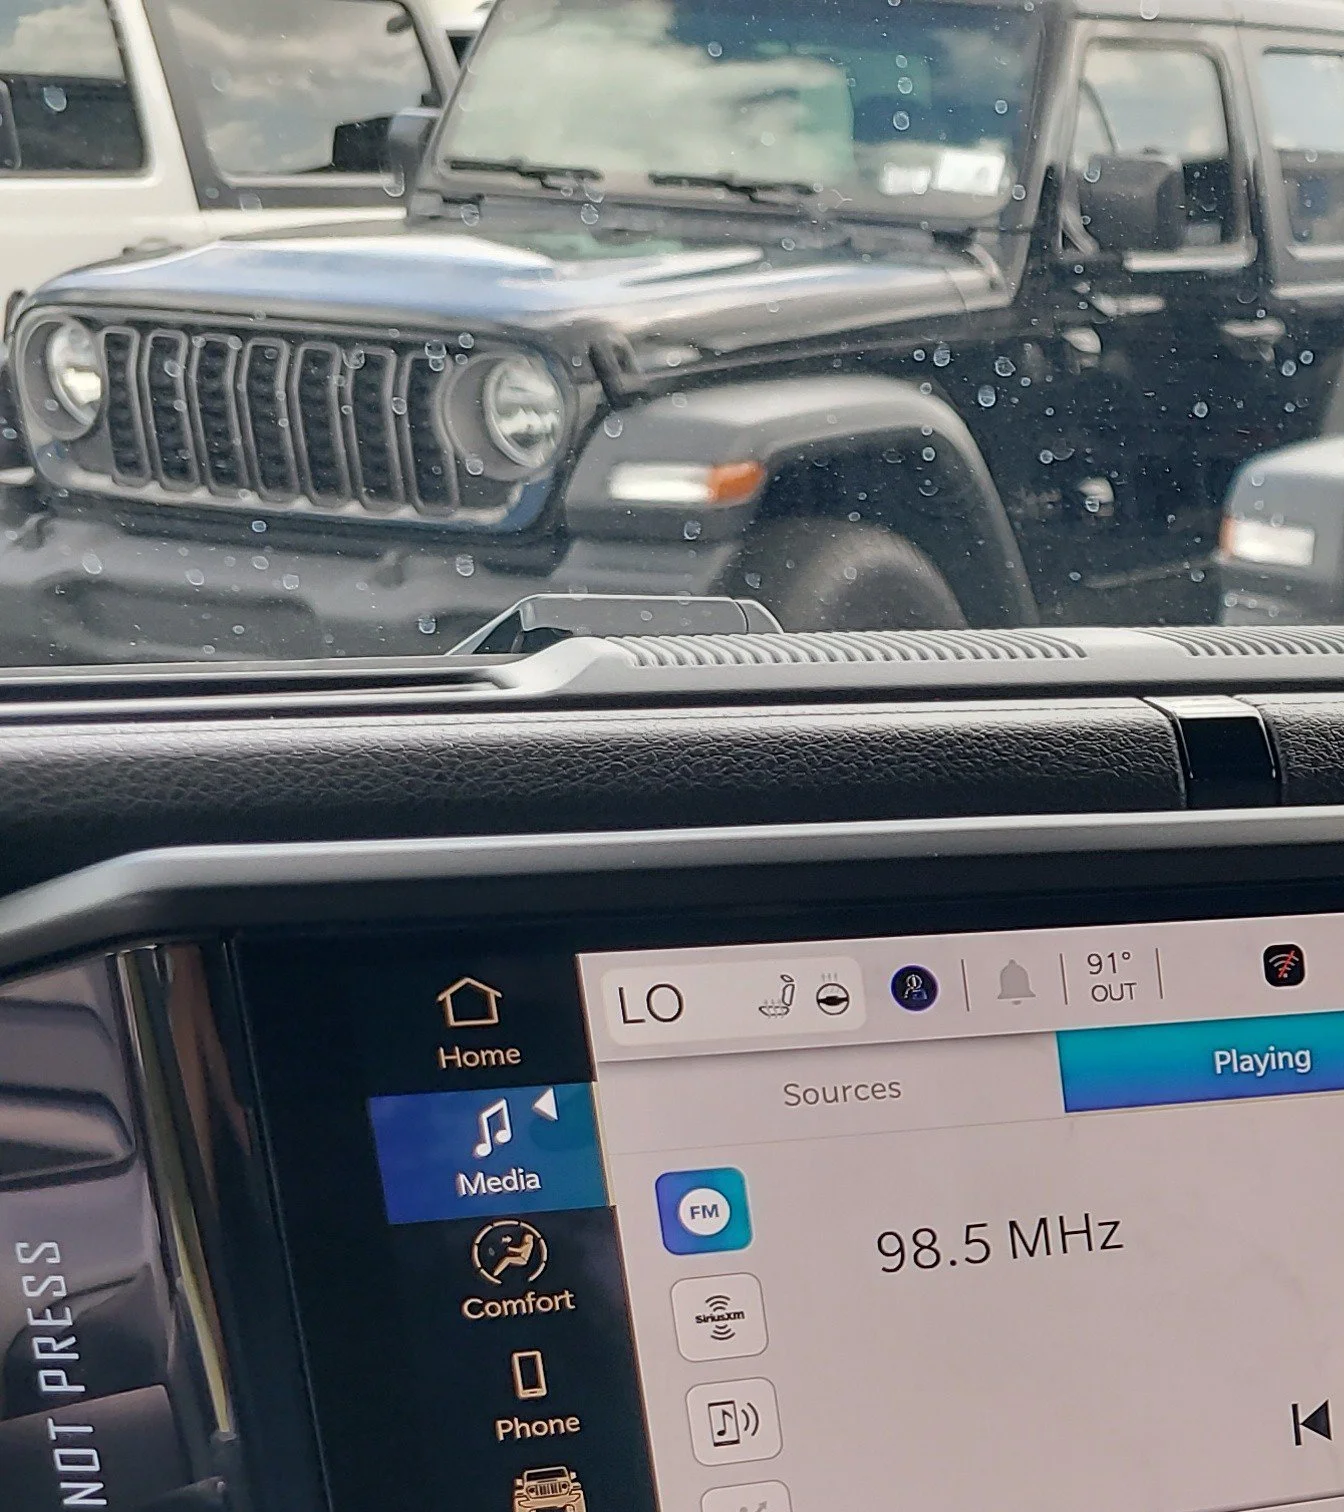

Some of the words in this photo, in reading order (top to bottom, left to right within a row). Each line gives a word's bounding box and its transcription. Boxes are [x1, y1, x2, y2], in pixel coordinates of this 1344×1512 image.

[1087, 951, 1132, 976] 91°
[619, 984, 685, 1026] LO
[1092, 981, 1136, 1003] OUT
[438, 1044, 522, 1069] Home
[1213, 1045, 1312, 1076] Playing
[784, 1077, 902, 1106] Sources
[457, 1167, 542, 1196] Media
[690, 1202, 720, 1221] FM
[876, 1224, 993, 1274] 98.5
[1008, 1211, 1124, 1260] MHz
[15, 1241, 86, 1393] PRESS
[462, 1289, 575, 1319] Comfort
[496, 1415, 580, 1441] Phone
[47, 1417, 108, 1506] NOT
